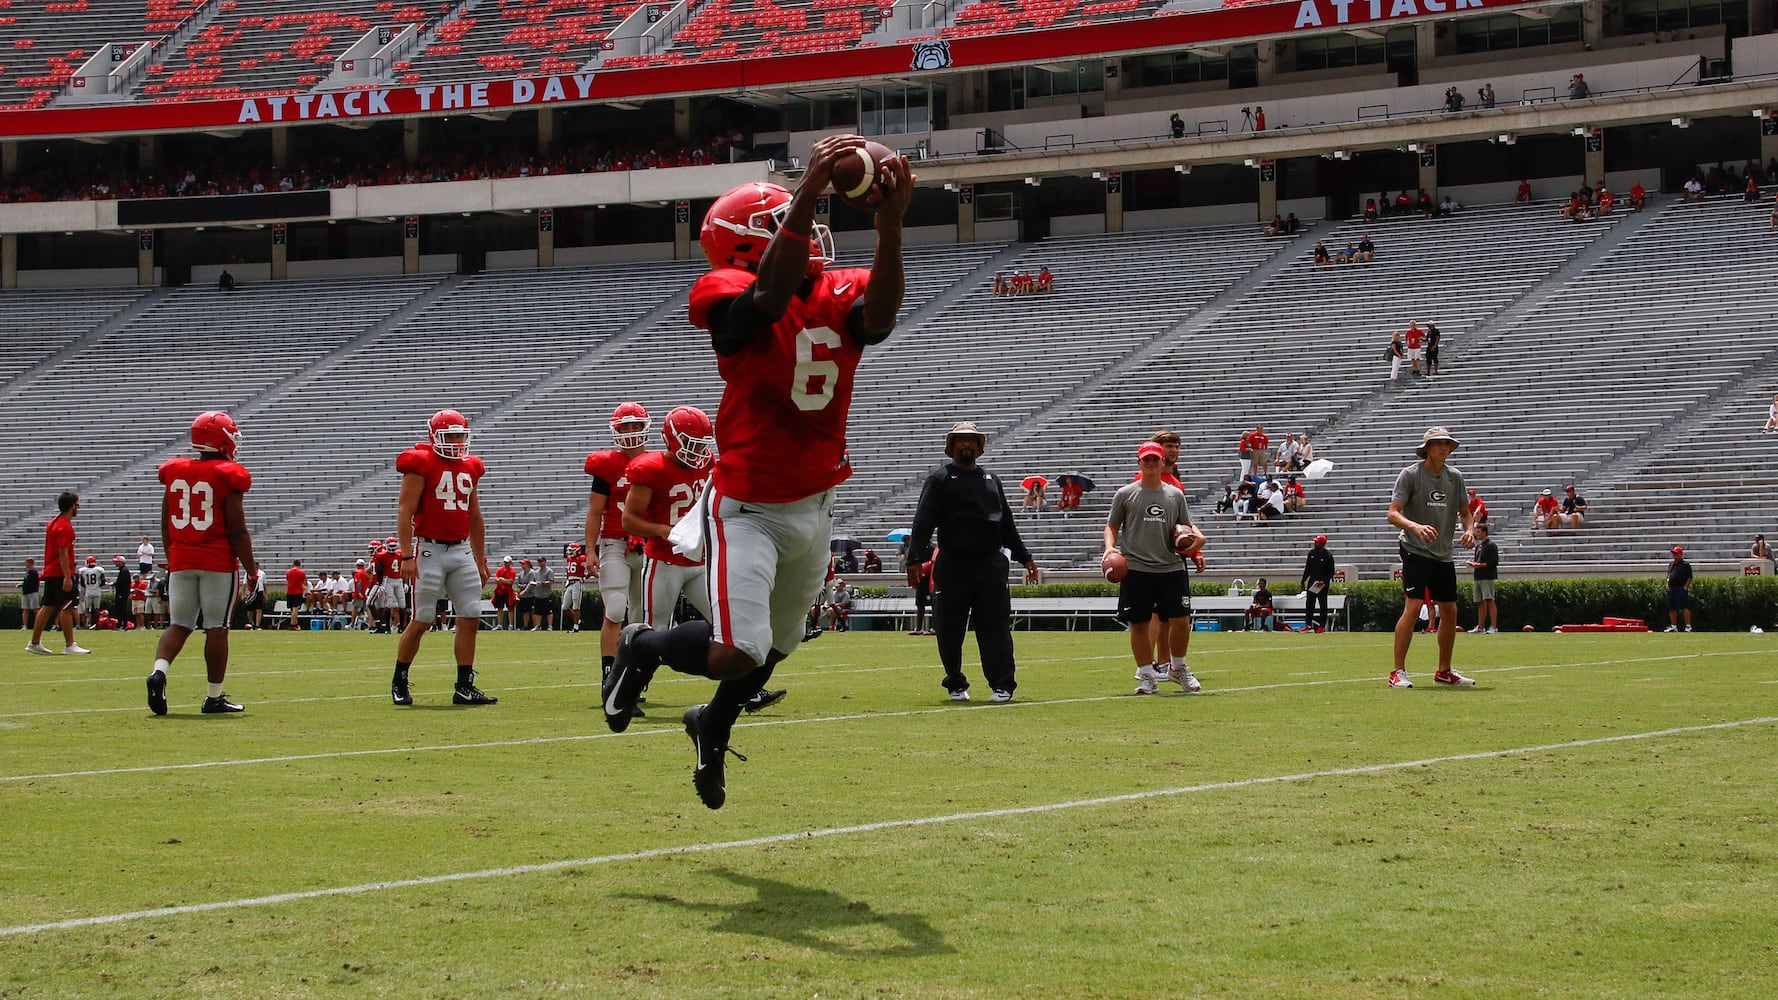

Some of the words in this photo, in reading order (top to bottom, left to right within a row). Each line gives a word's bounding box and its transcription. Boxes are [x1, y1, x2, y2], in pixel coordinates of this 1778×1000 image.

[238, 90, 391, 122] ATTACK
[415, 83, 489, 110] THE
[513, 74, 595, 103] DAY
[791, 326, 842, 411] 6
[170, 479, 213, 531] 33
[435, 470, 473, 511] 49
[1147, 505, 1165, 516] G
[85, 574, 97, 585] 18
[391, 559, 399, 573] 4
